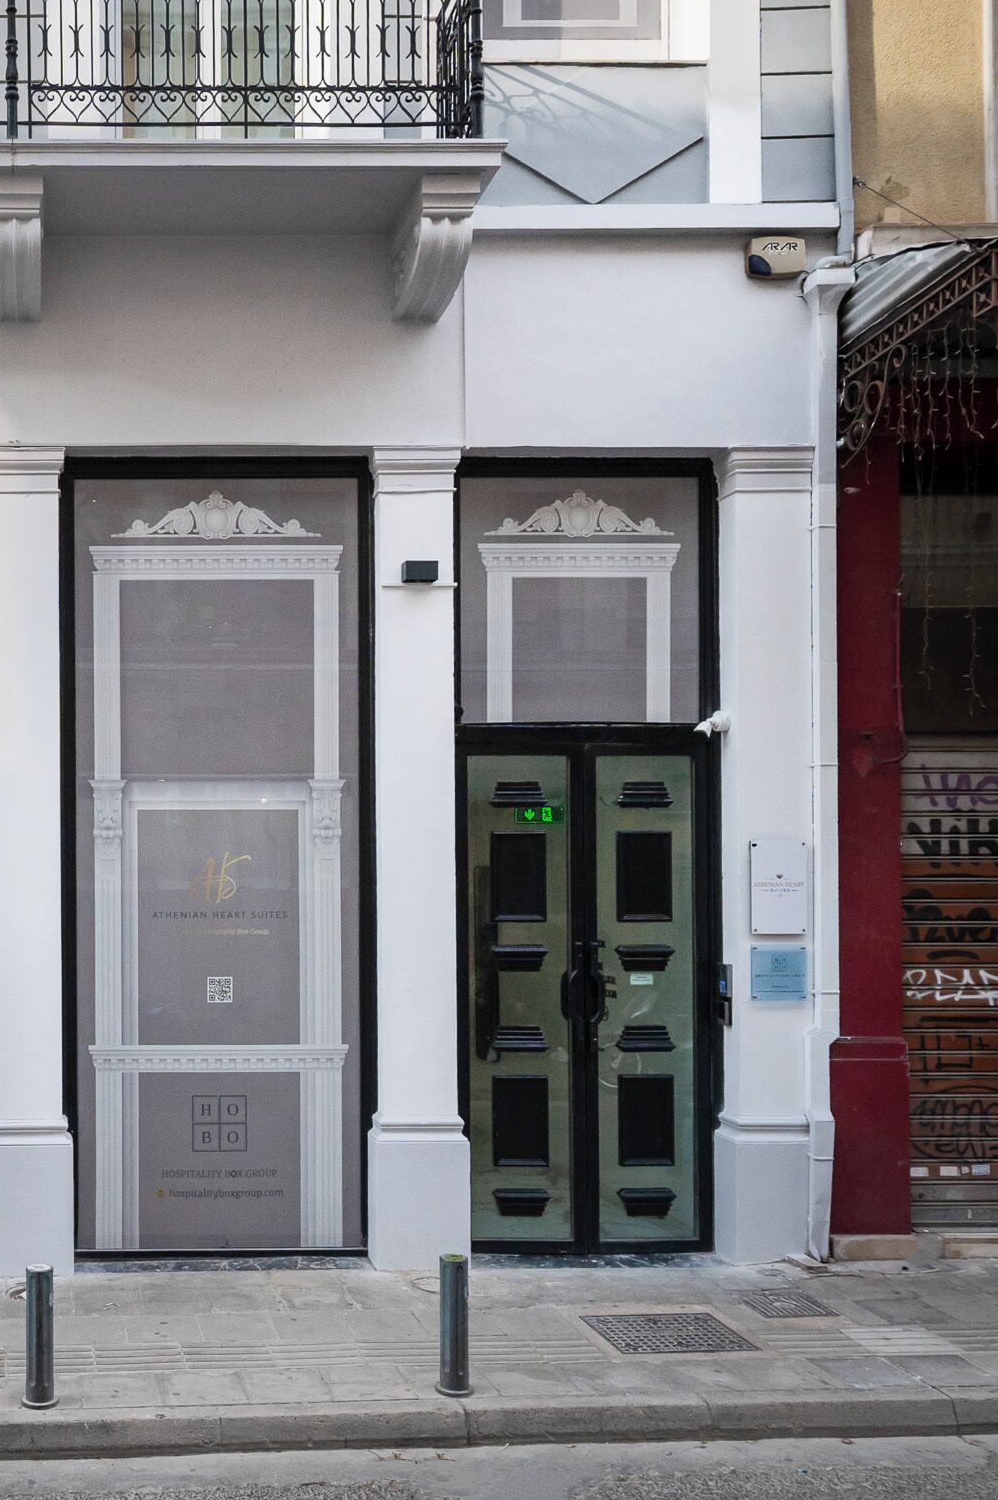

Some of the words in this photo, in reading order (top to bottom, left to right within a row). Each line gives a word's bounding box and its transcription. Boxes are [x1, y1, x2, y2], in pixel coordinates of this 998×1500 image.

[152, 910, 208, 920] ATHENIAN
[212, 910, 246, 919] HEART
[251, 910, 289, 919] SUITES
[162, 1169, 222, 1179] HOSPITALITY
[225, 1169, 243, 1178] BOX
[245, 1169, 278, 1178] GROUP
[168, 1188, 285, 1200] hospitalityboxgroup.com
